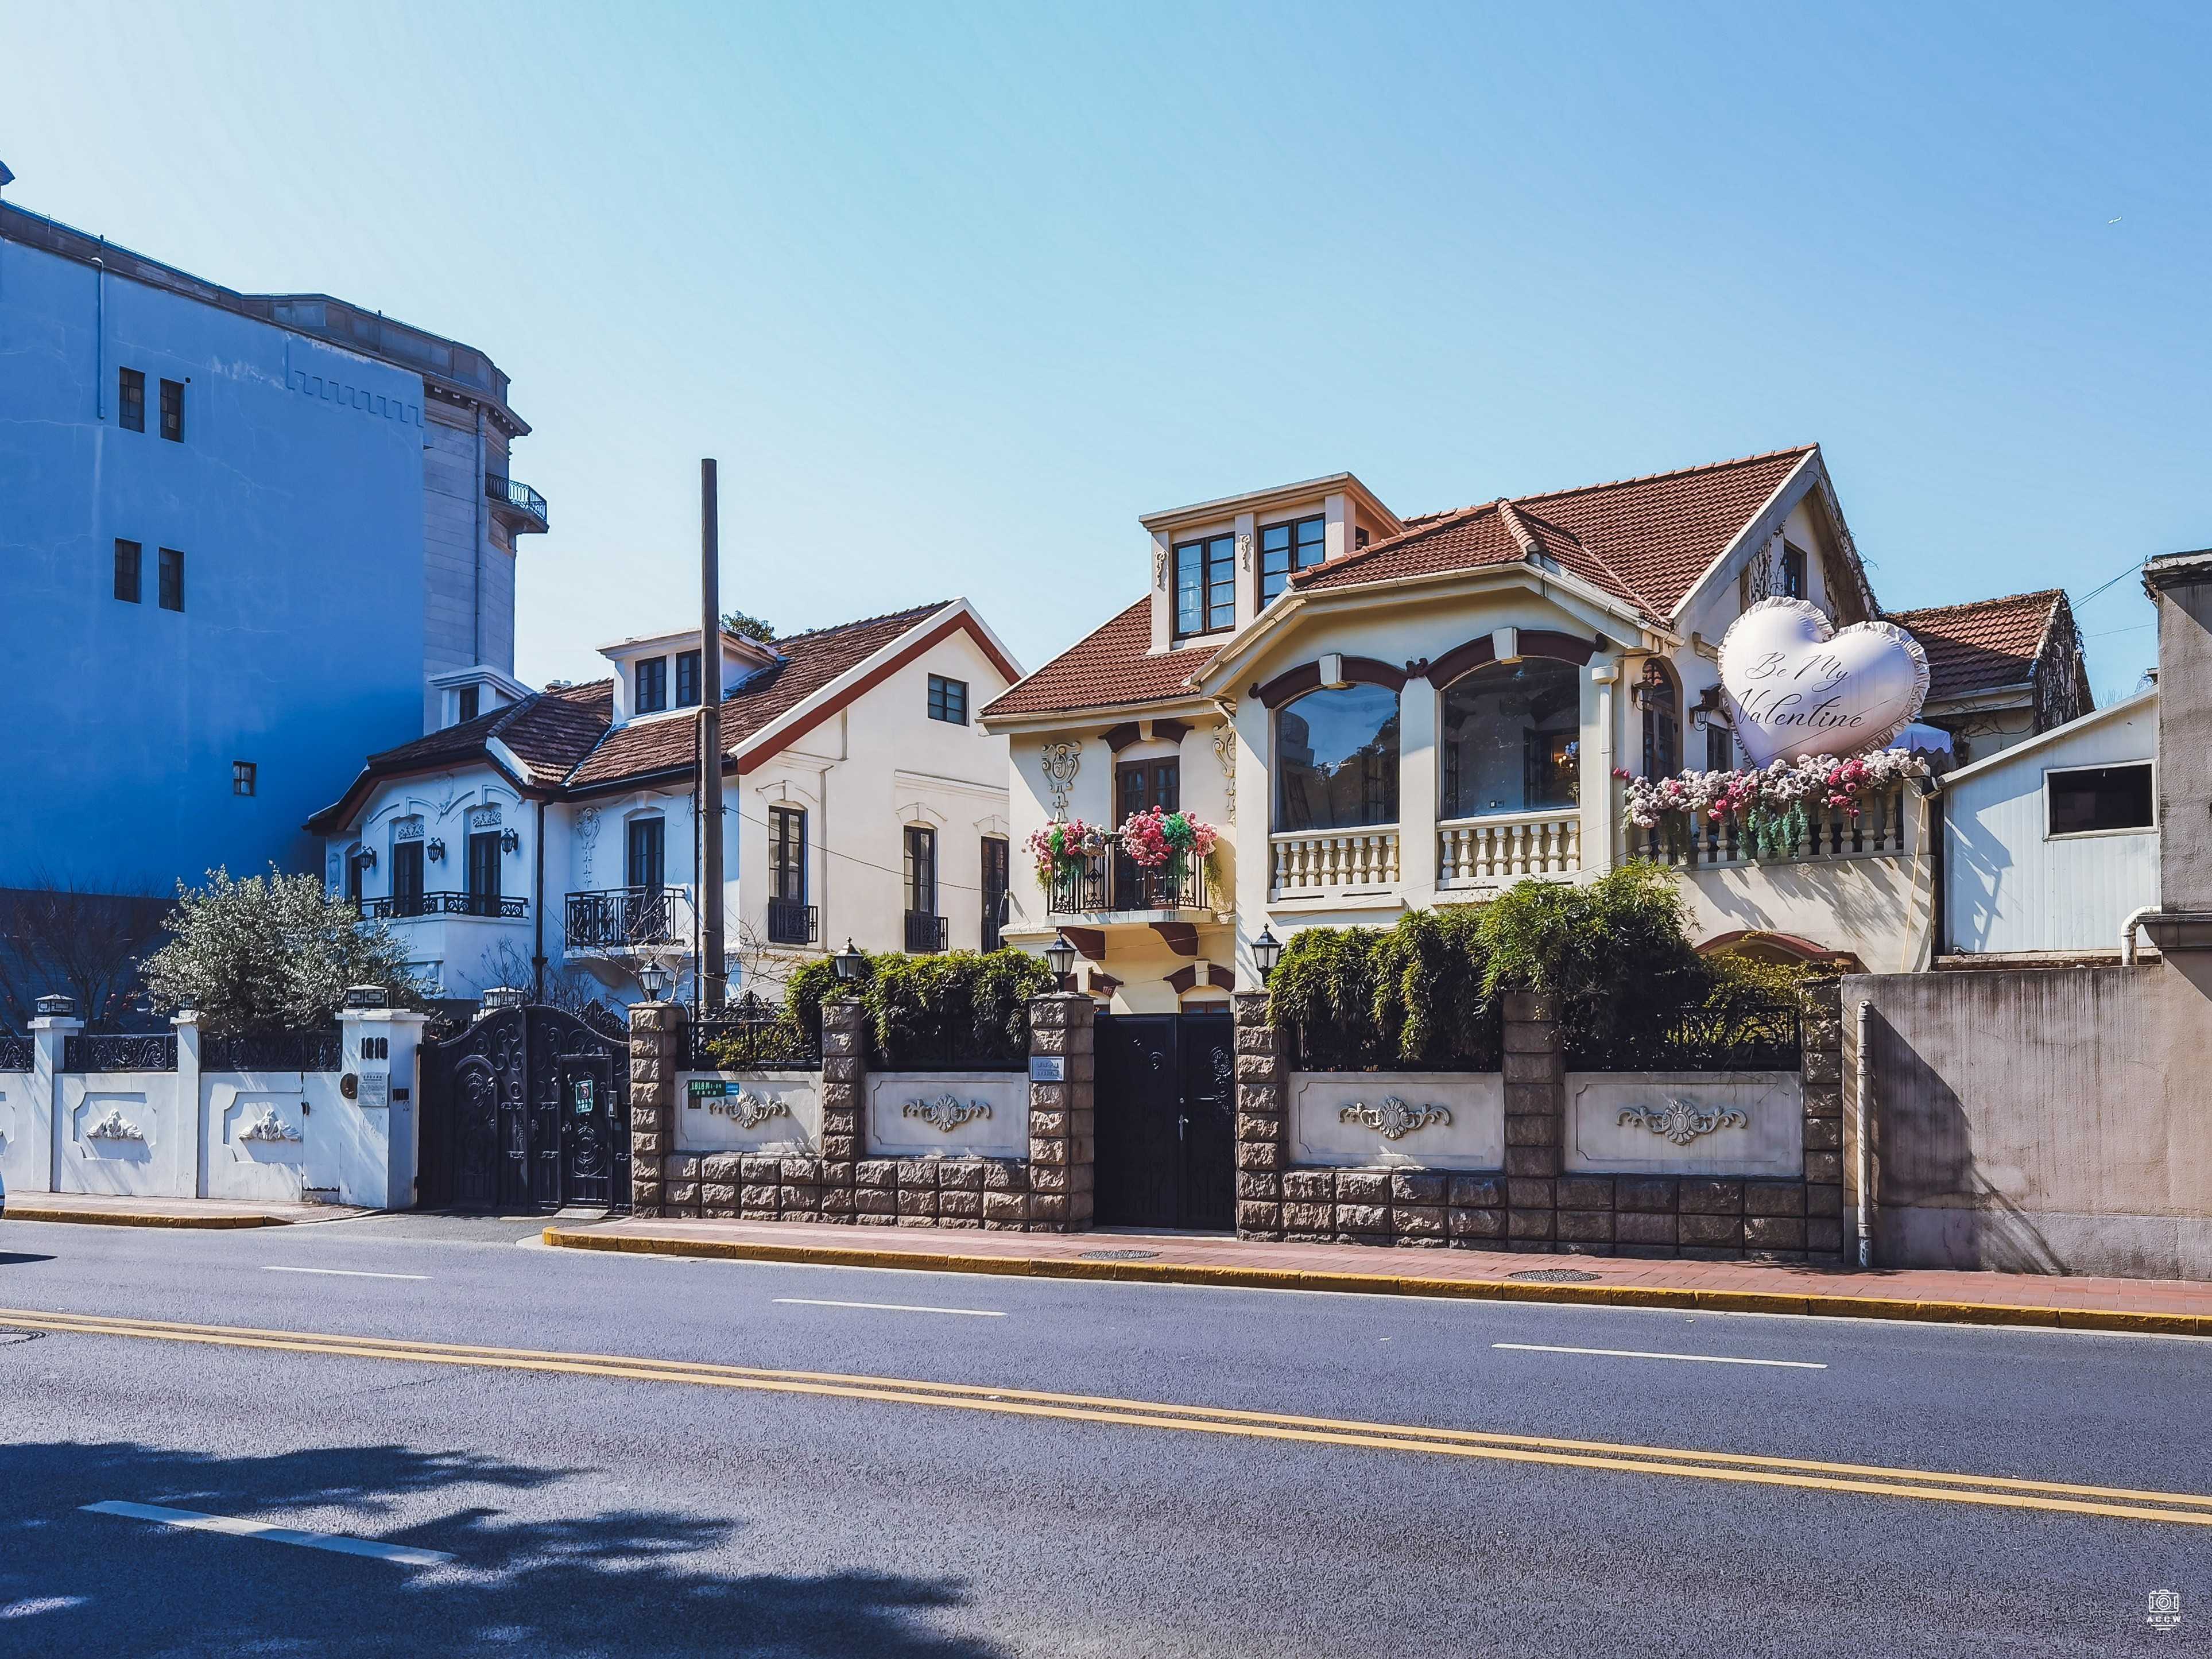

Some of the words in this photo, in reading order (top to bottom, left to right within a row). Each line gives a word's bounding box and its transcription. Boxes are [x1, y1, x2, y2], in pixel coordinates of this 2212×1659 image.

[1745, 652, 1788, 679] Be
[1794, 654, 1851, 692] My
[1737, 688, 1865, 727] Valentine
